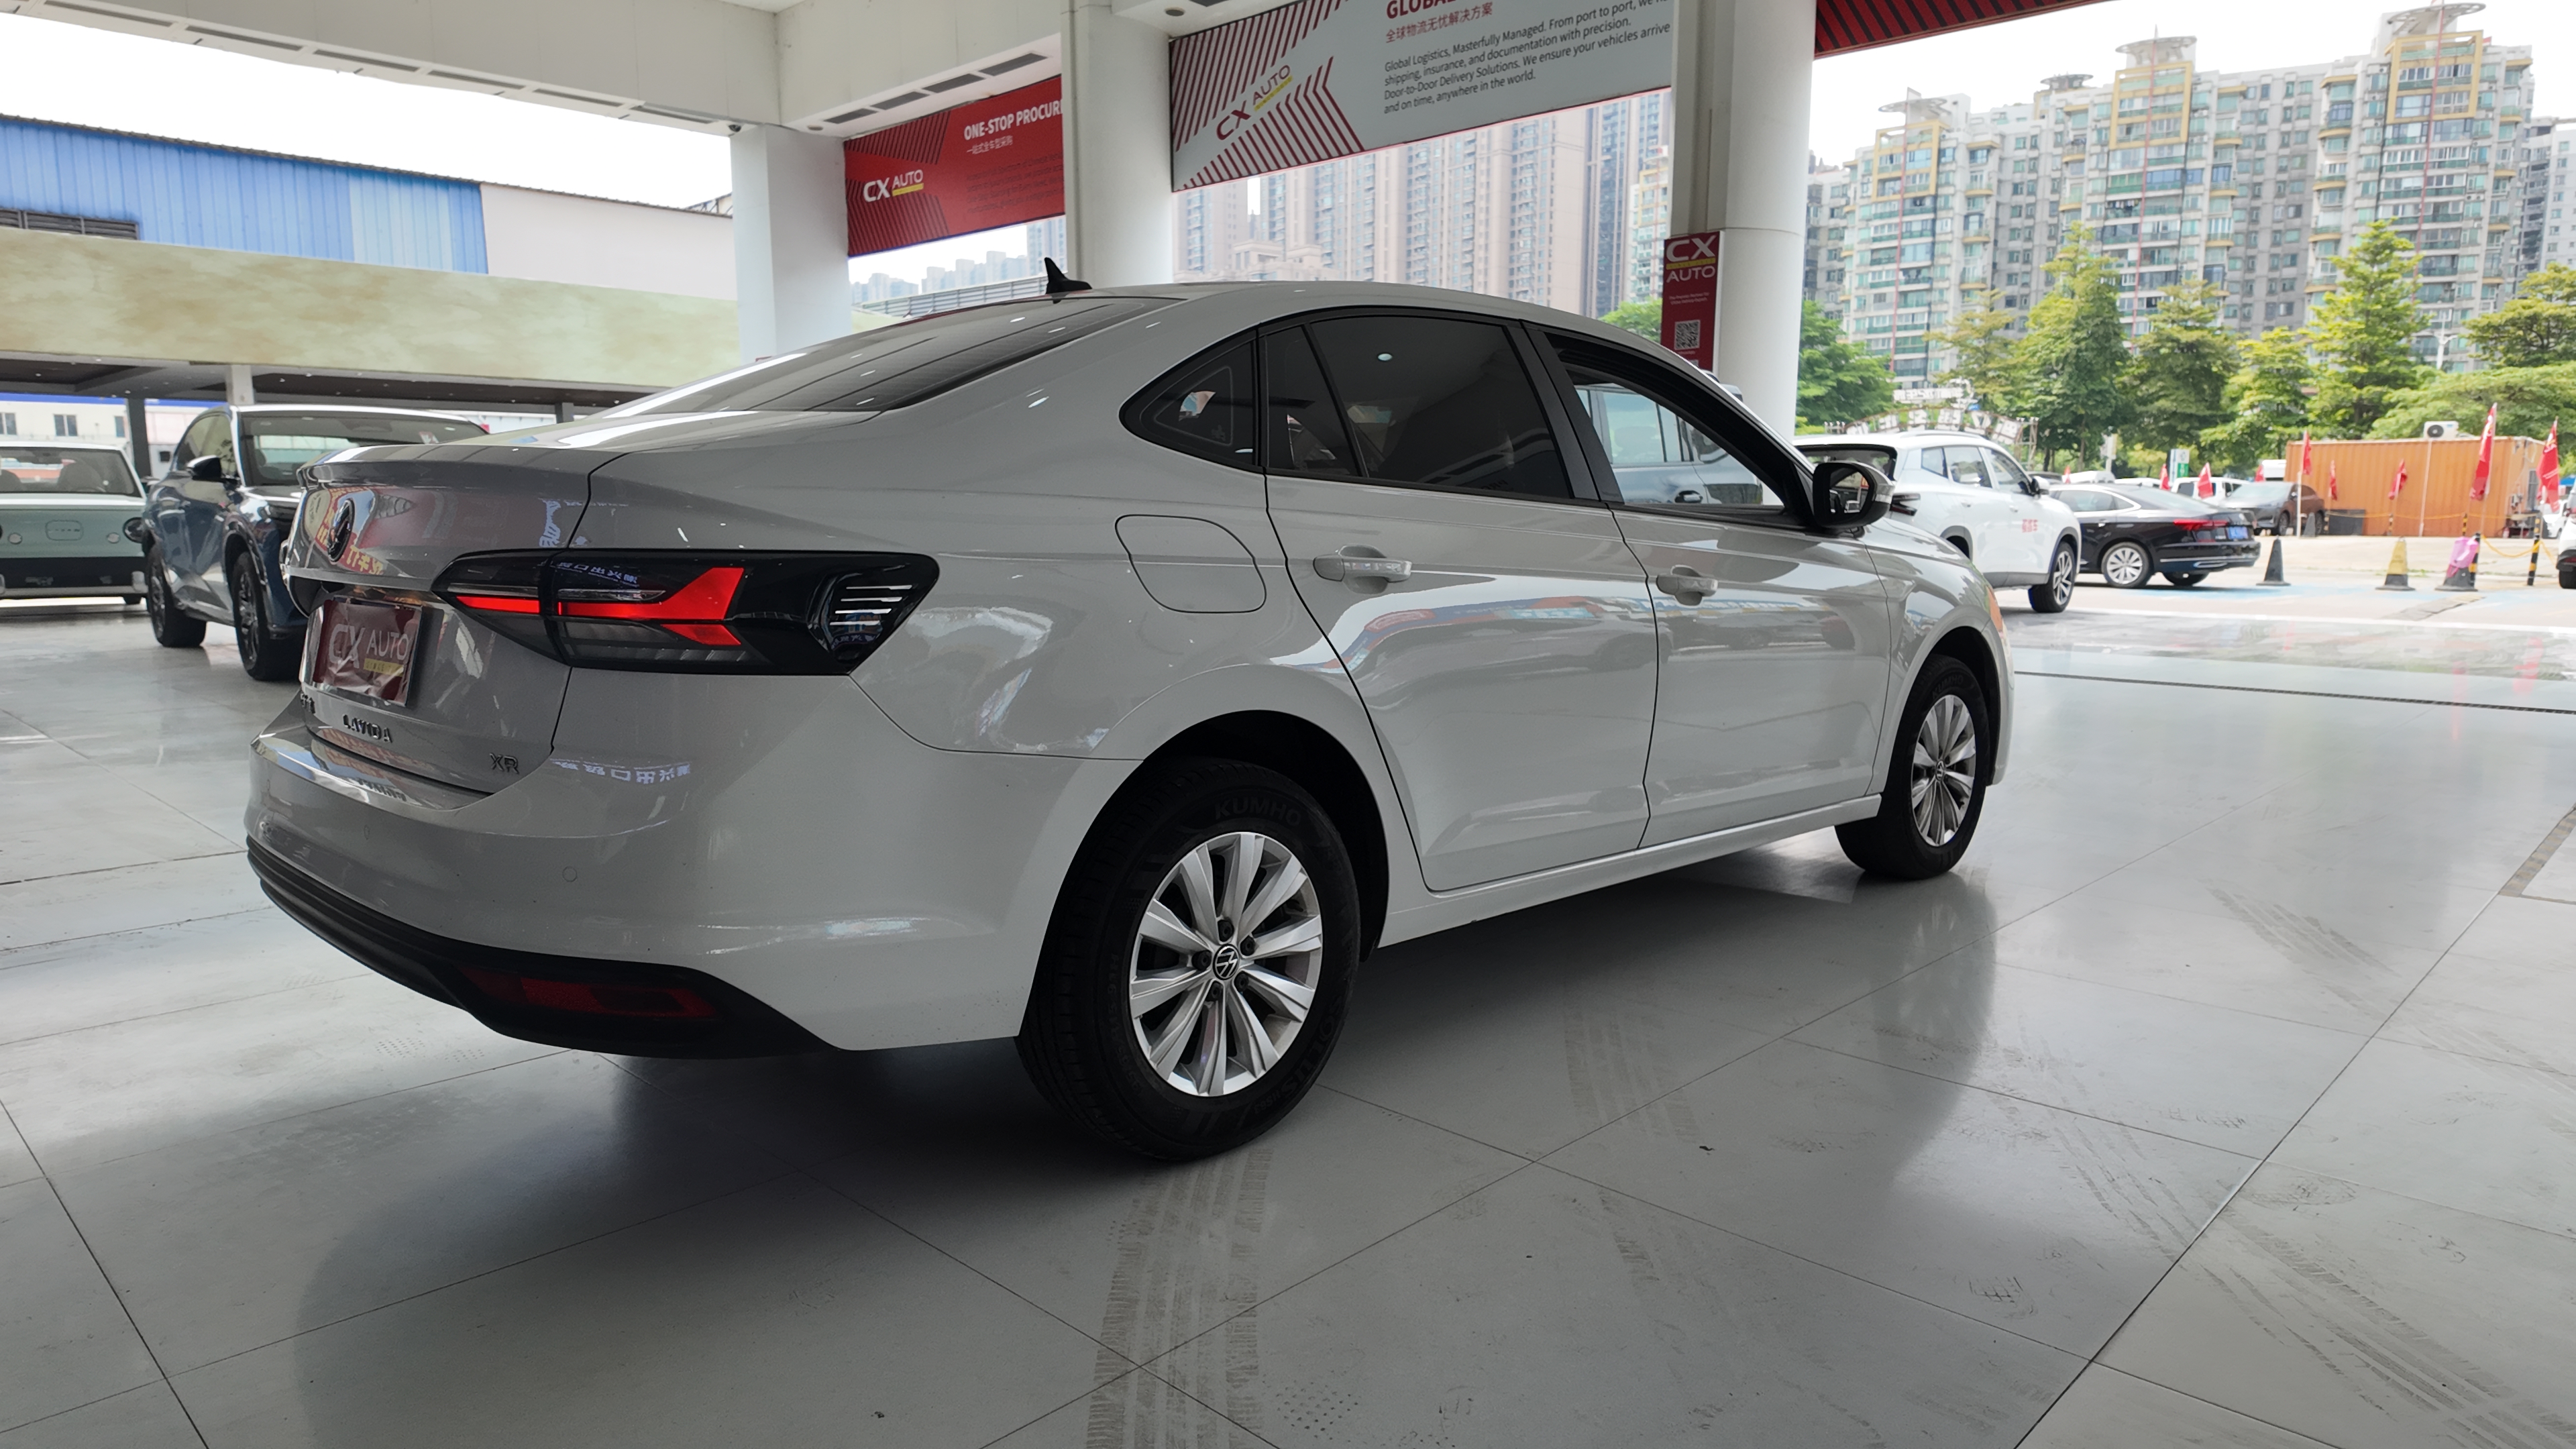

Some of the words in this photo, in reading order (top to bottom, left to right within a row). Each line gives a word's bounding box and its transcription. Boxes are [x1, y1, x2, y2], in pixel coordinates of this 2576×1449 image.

[1386, 1, 1493, 43] 全球物流无忧解决方案
[1387, 0, 1456, 19] GLOB
[1385, 56, 1411, 72] Global
[1413, 48, 1451, 66] Logistics,
[1453, 34, 1501, 55] Masterfully
[1503, 21, 1547, 42] Managed.
[1549, 16, 1574, 30] From
[1576, 9, 1597, 23] port
[1599, 7, 1609, 17] to
[1611, 0, 1636, 17] port,
[1385, 70, 1422, 87] shipping,
[1424, 58, 1467, 76] insurance,
[1468, 52, 1485, 66] and
[1487, 34, 1558, 61] documentation
[1560, 28, 1580, 42] with
[1583, 18, 1631, 40] precision.
[1384, 79, 1438, 100] Door-to-Door
[1440, 70, 1474, 87] Delivery
[1476, 60, 1520, 78] Solutions.
[1523, 55, 1538, 66] We
[1539, 47, 1571, 63] ensure
[1573, 41, 1596, 58] your
[1598, 30, 1638, 49] vehicles
[1640, 23, 1670, 39] arrive
[1216, 100, 1251, 140] CX
[1252, 65, 1291, 105] AUTO
[1384, 101, 1399, 114] and
[1401, 100, 1412, 110] on
[1413, 95, 1435, 108] time,
[1436, 83, 1479, 102] anywhere
[1480, 80, 1489, 92] in
[1491, 77, 1505, 89] the
[1507, 68, 1536, 85] world.
[964, 113, 1014, 140] ONE-STOP
[1016, 100, 1063, 125] PROCUR
[863, 176, 890, 202] CX
[892, 170, 924, 190] AUTO
[1666, 235, 1716, 262] CX
[1666, 266, 1715, 283] AUTO
[328, 624, 366, 669] CX
[366, 630, 409, 660] AUTO
[489, 752, 520, 774] XR
[1214, 796, 1302, 827] KUMHO
[1281, 995, 1342, 1099] SOLUS
